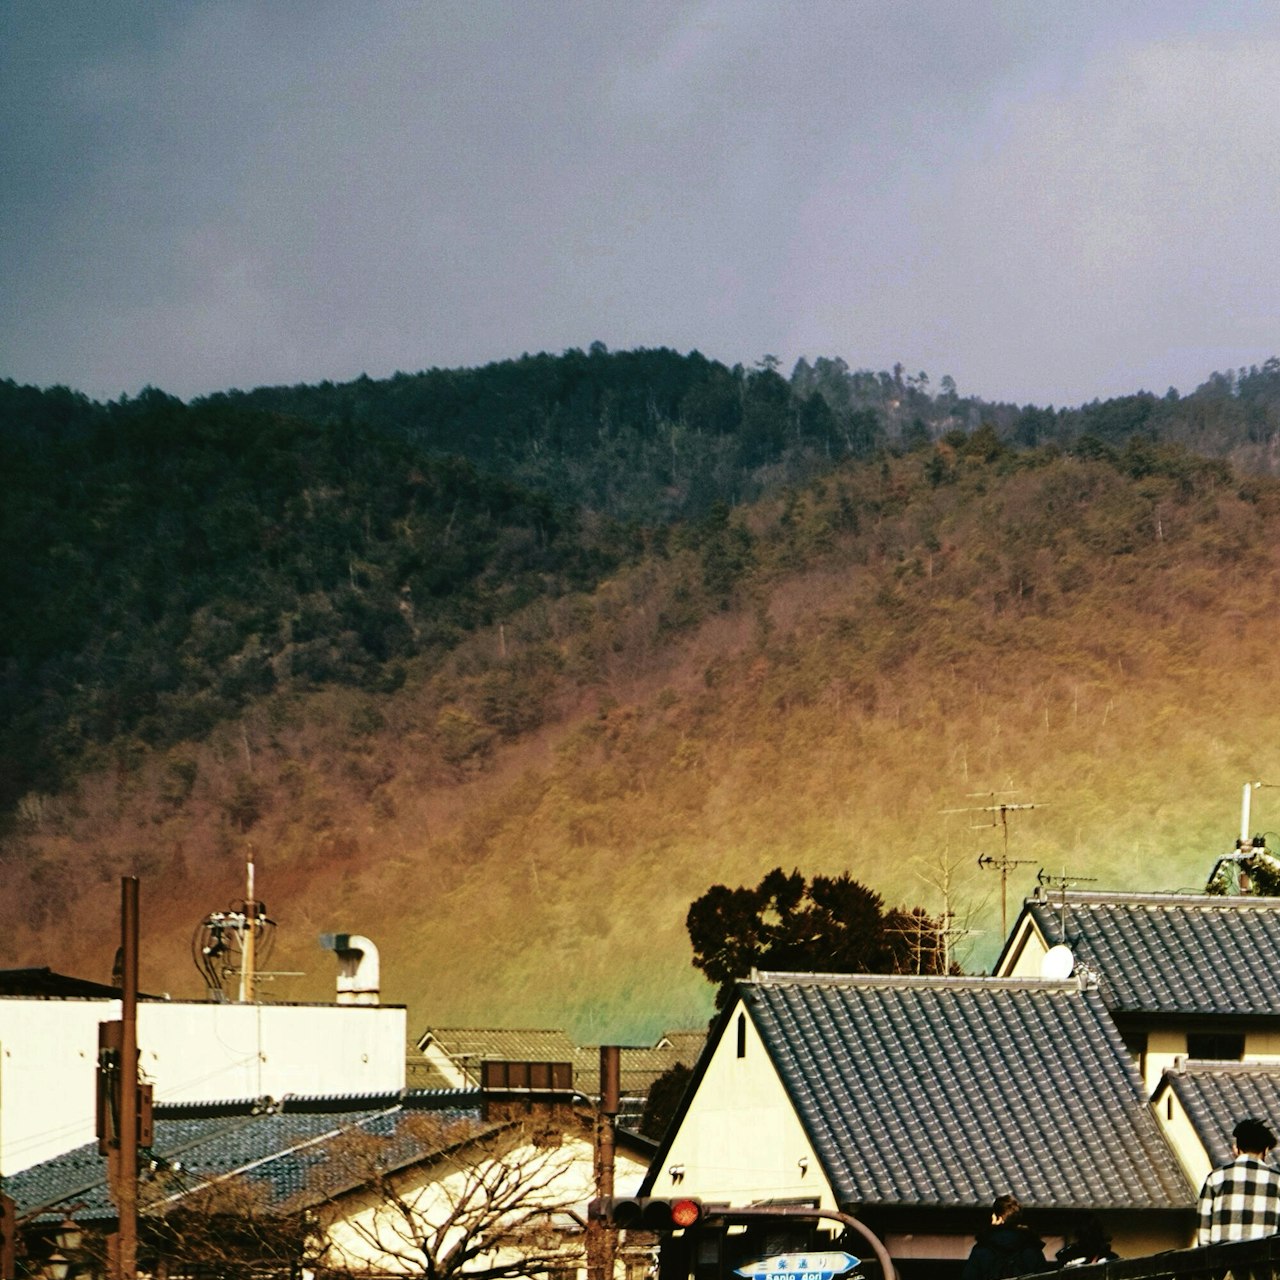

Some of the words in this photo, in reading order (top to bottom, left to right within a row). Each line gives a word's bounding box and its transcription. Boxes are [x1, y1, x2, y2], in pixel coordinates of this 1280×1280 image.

[758, 1259, 827, 1270] 三条通り
[801, 1272, 822, 1280] dori
